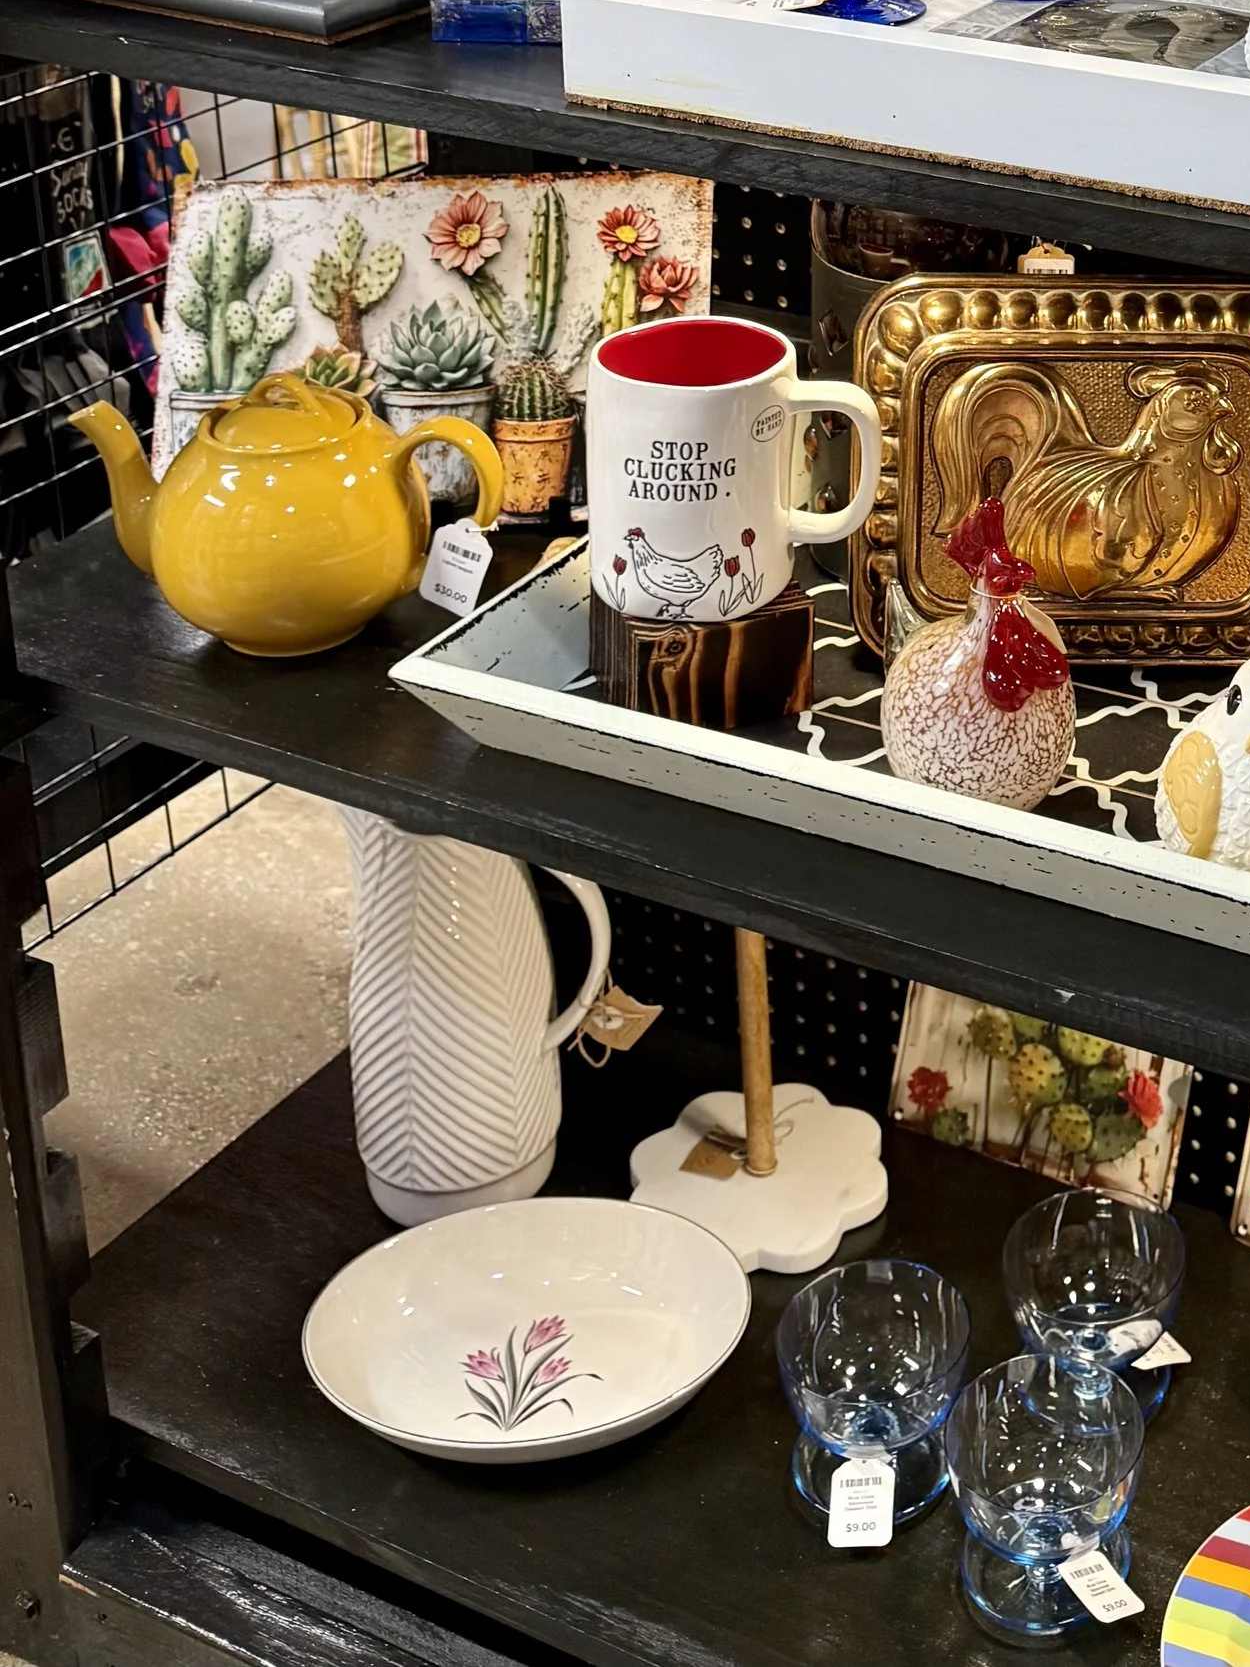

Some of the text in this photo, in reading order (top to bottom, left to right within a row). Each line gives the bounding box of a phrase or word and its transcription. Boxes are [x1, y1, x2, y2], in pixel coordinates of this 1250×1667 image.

[651, 440, 709, 460] STOP
[624, 457, 736, 481] CLUCKING
[434, 583, 467, 604] $30.00
[846, 1521, 876, 1533] $9.00
[1102, 1599, 1128, 1613] $9.00
